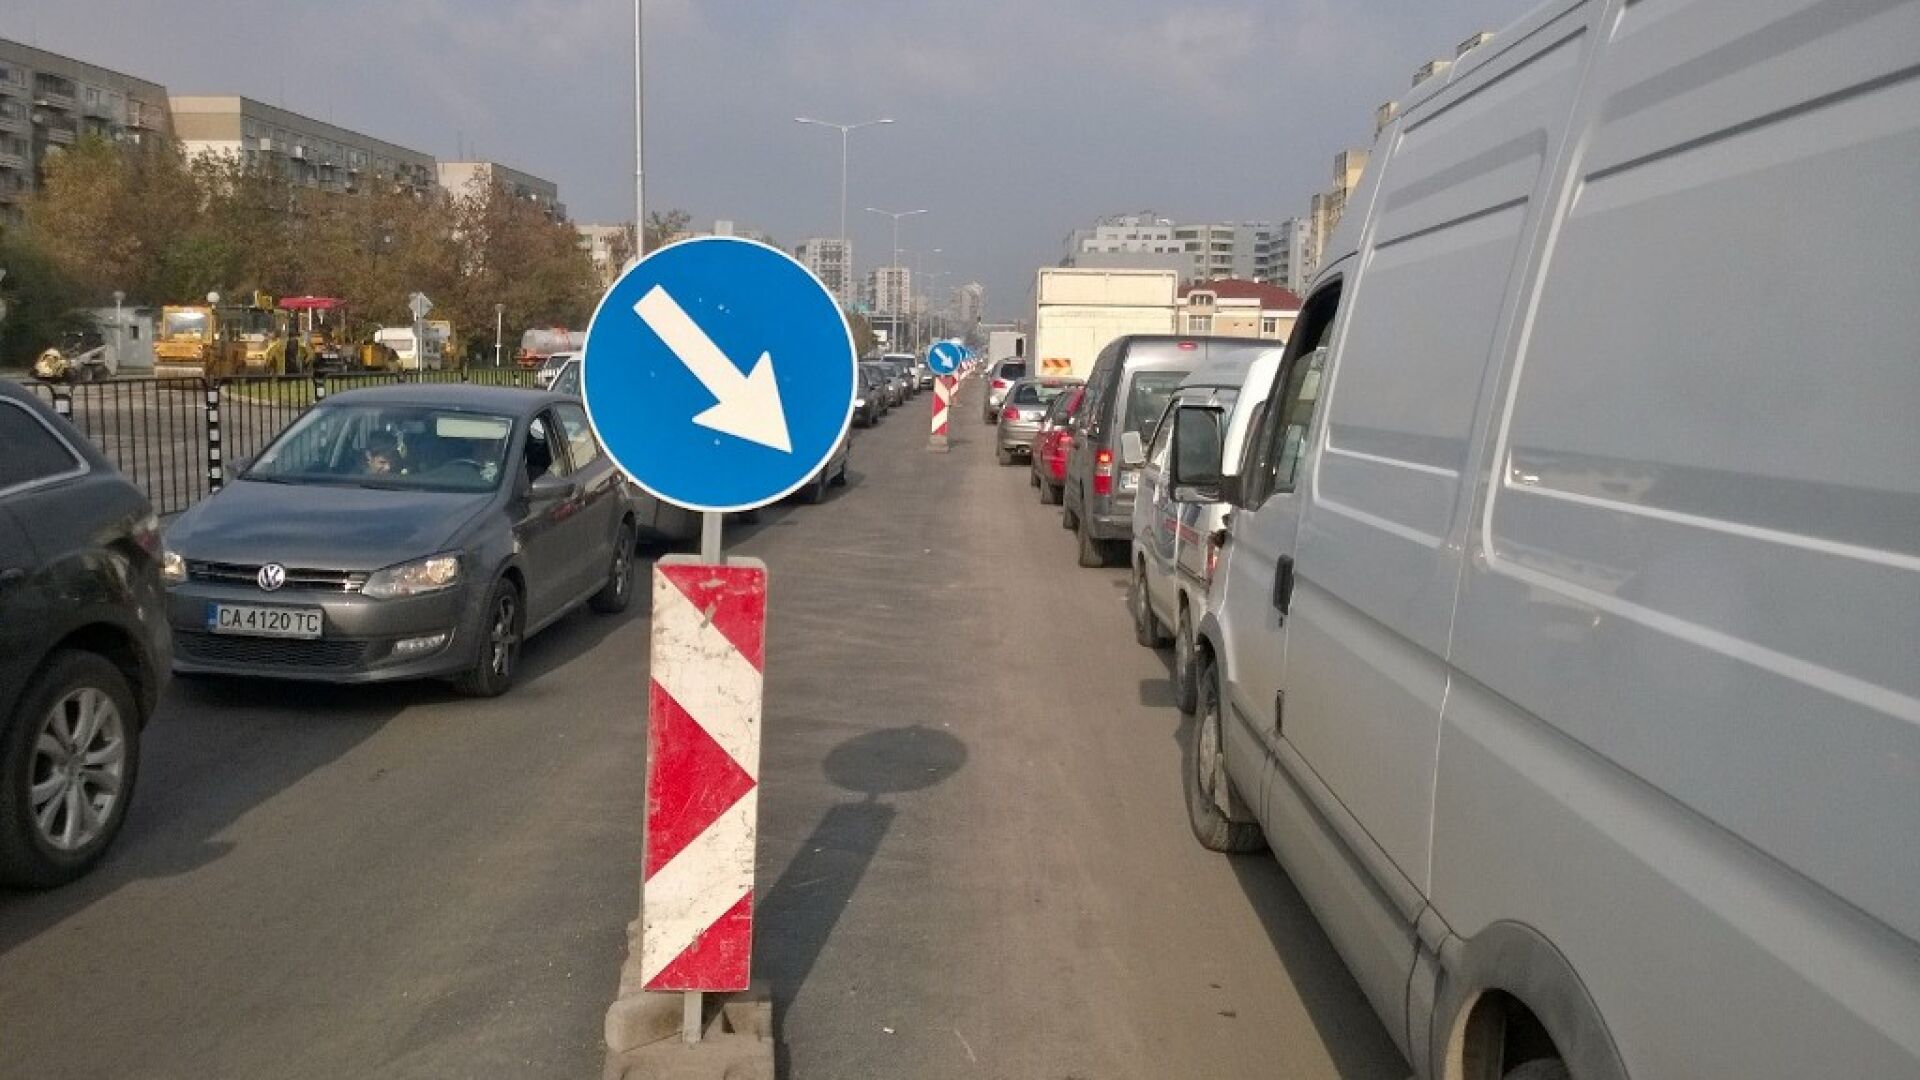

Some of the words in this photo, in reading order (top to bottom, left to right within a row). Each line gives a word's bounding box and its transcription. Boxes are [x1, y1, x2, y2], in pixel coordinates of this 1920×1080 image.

[220, 608, 242, 628] CA
[246, 610, 291, 631] 4120
[295, 612, 318, 633] TC
